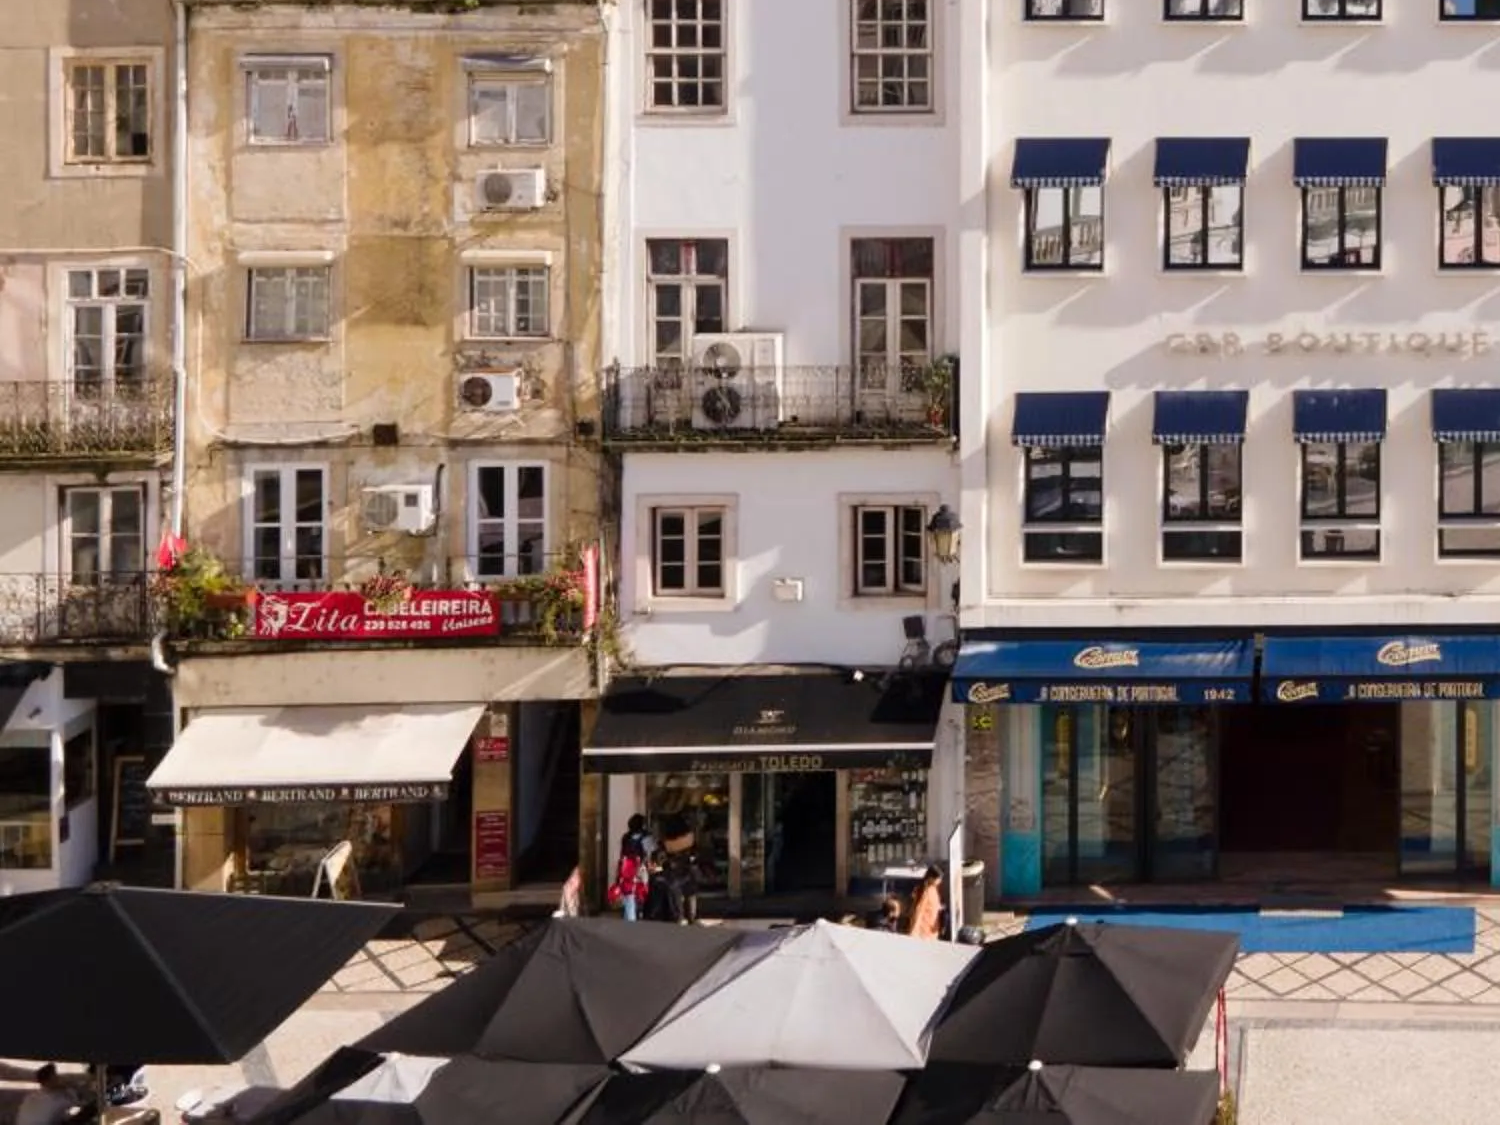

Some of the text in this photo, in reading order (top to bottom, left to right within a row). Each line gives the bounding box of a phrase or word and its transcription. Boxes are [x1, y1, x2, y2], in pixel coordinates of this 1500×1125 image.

[1164, 331, 1244, 357] CBR
[1264, 330, 1490, 357] BOUTIQUE
[364, 599, 492, 616] CBELEIREIRA
[290, 601, 360, 632] Zita
[1203, 689, 1236, 701] 1942
[759, 755, 823, 770] TOLEDO
[169, 786, 429, 804] BERTRAND BERTRAND BERTRAND
